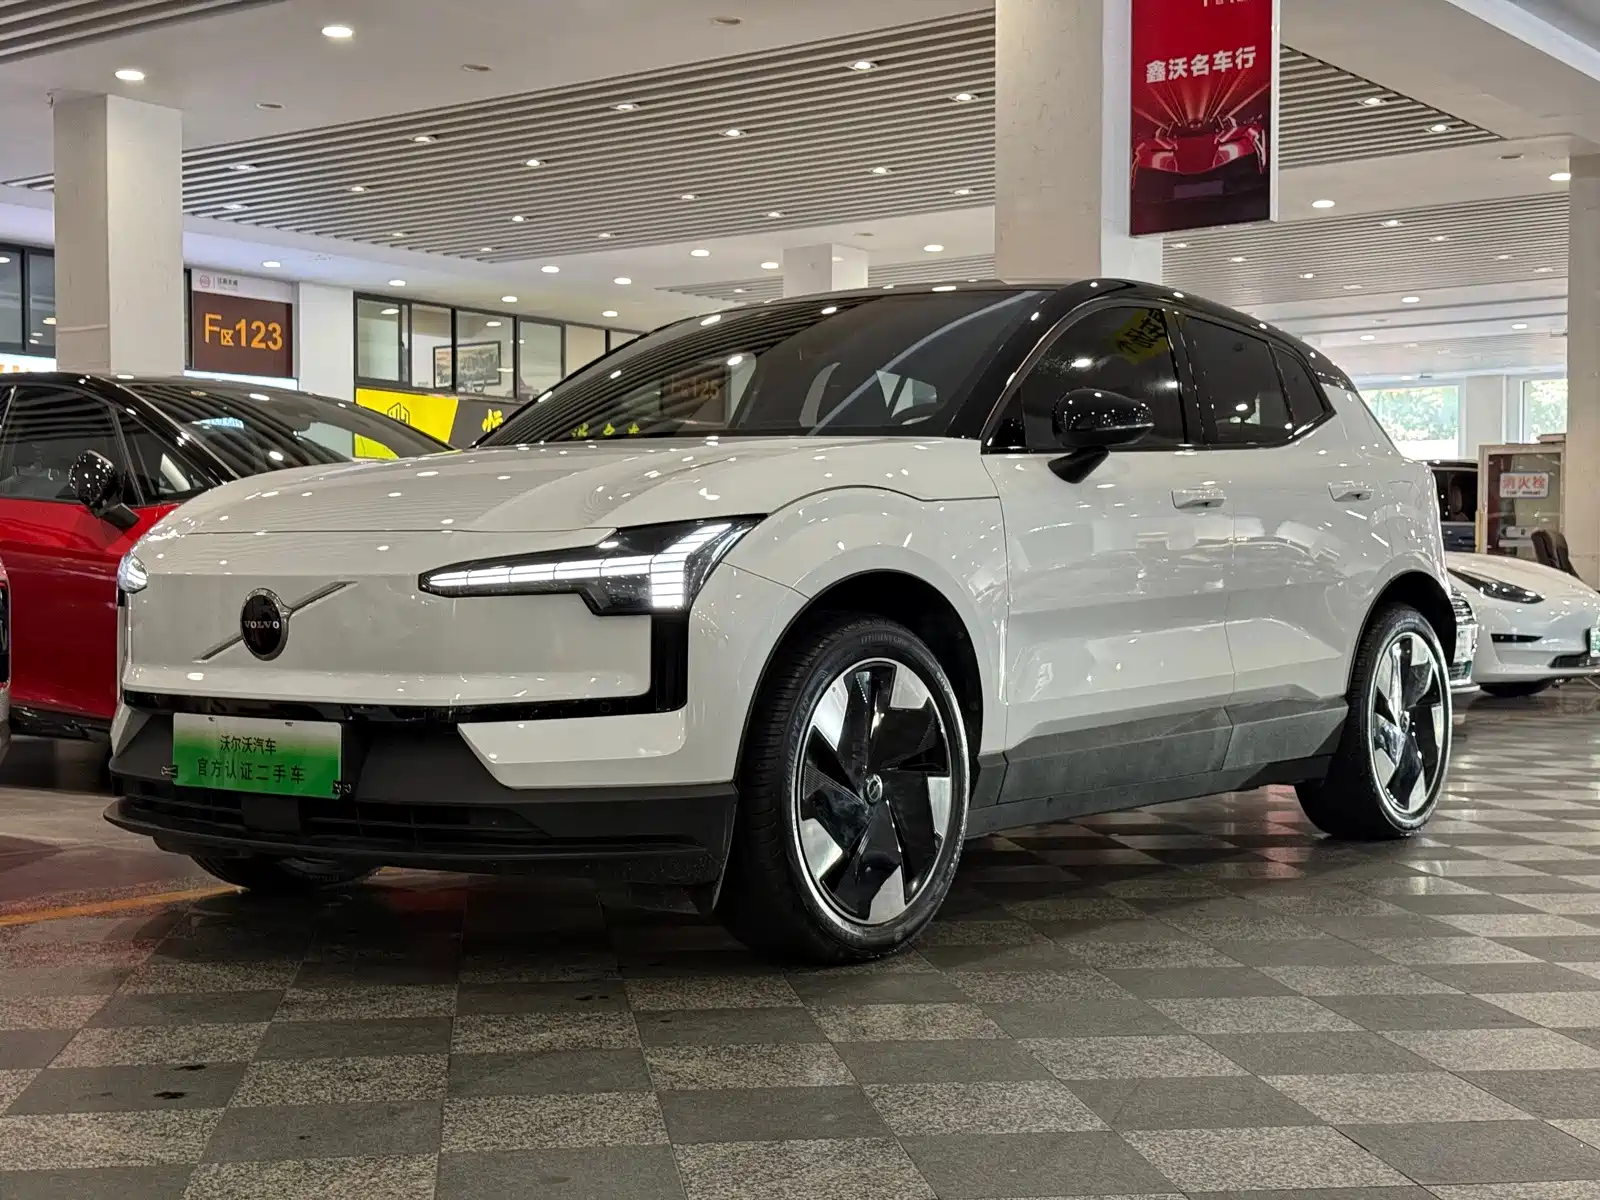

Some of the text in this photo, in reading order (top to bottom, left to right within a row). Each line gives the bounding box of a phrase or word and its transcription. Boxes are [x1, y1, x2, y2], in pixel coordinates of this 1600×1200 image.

[1146, 46, 1256, 84] 鑫沃名车行
[204, 312, 283, 351] F区123
[244, 620, 280, 629] VOLVO
[219, 734, 277, 754] 沃尔沃汽车
[197, 757, 306, 785] 官方认证二手车
